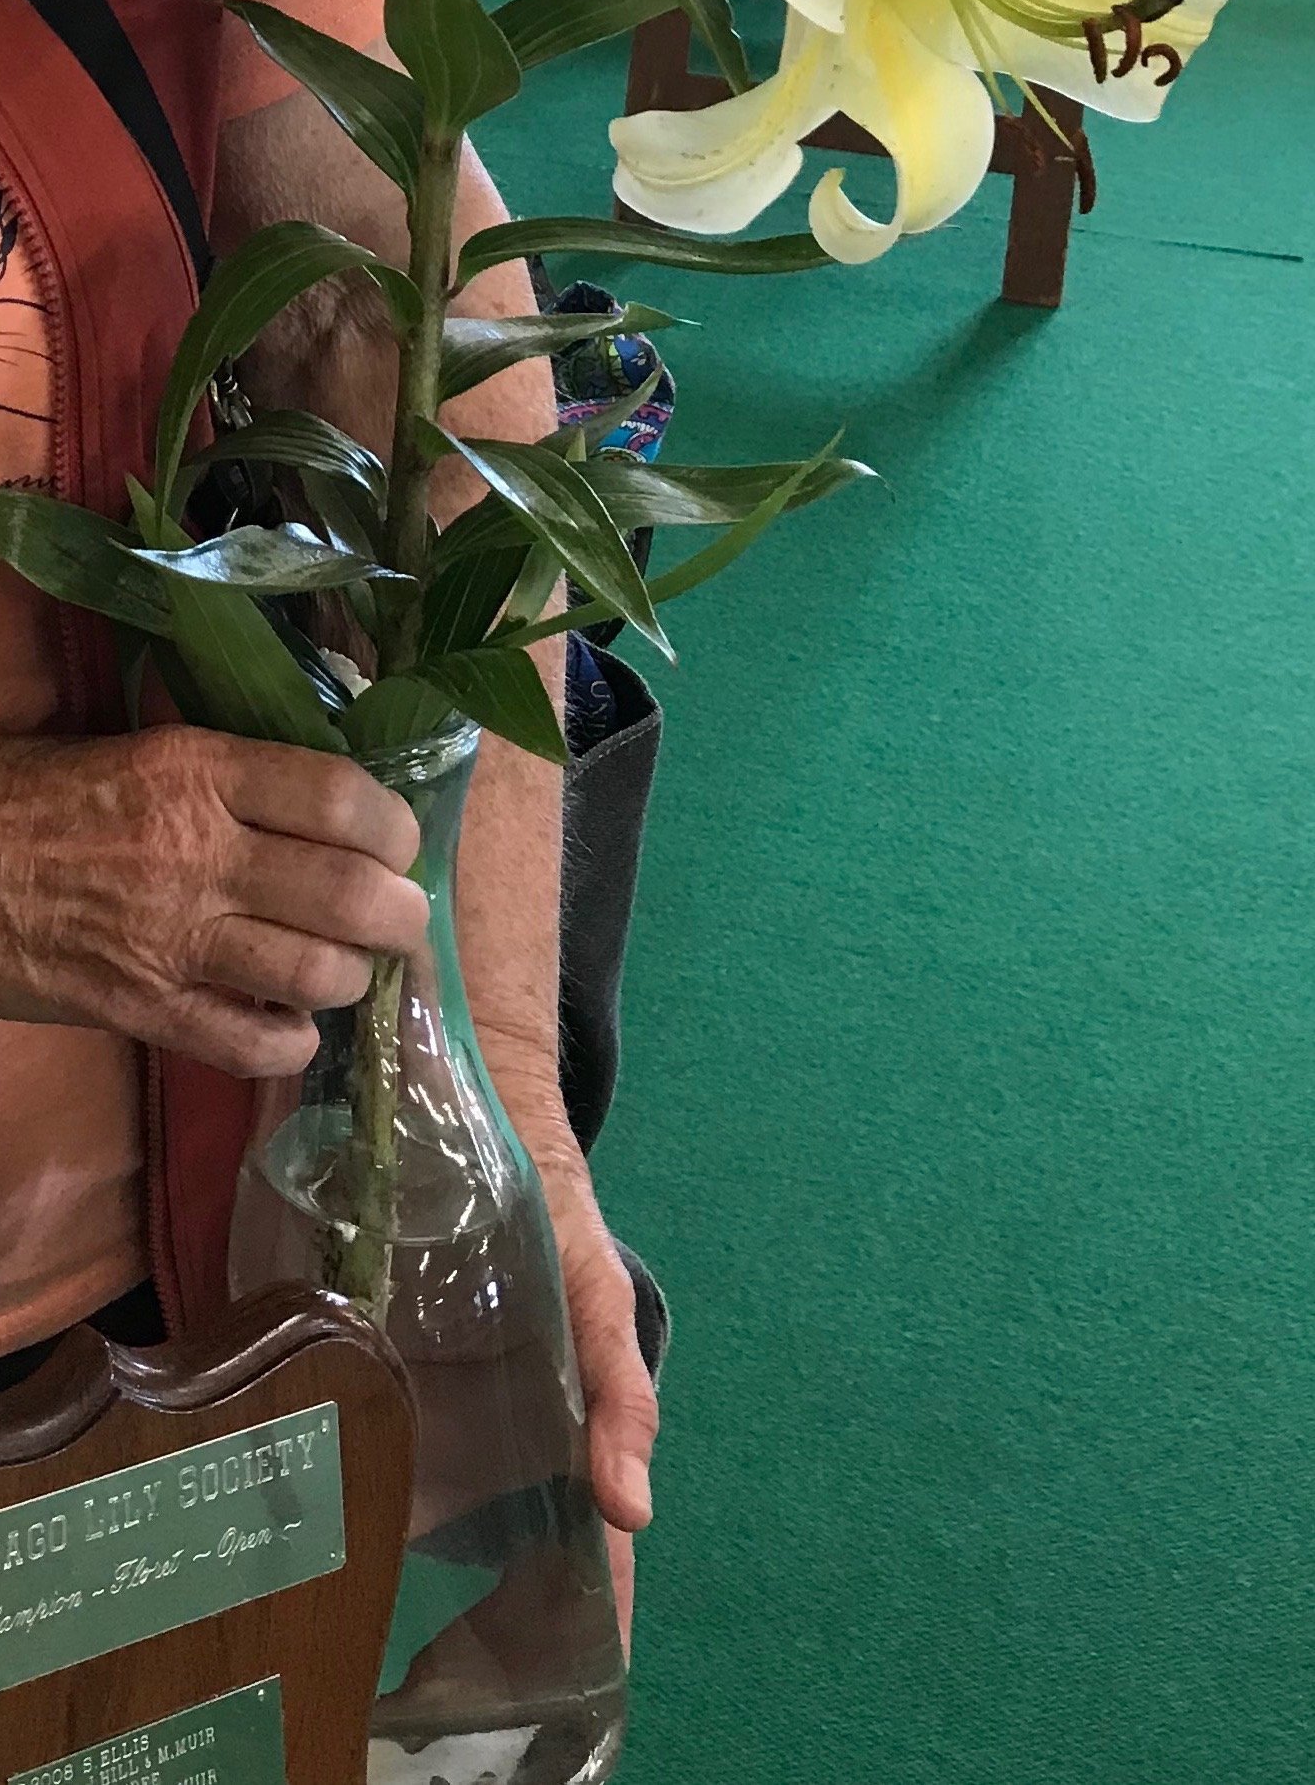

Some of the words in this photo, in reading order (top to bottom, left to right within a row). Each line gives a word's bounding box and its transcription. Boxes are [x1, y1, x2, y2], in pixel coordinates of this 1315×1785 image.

[83, 1480, 162, 1543] LILY
[177, 1430, 316, 1510] SOCIETY
[109, 1548, 185, 1596] Floret
[216, 1526, 273, 1567] Open
[158, 1726, 216, 1765] M.MUIR
